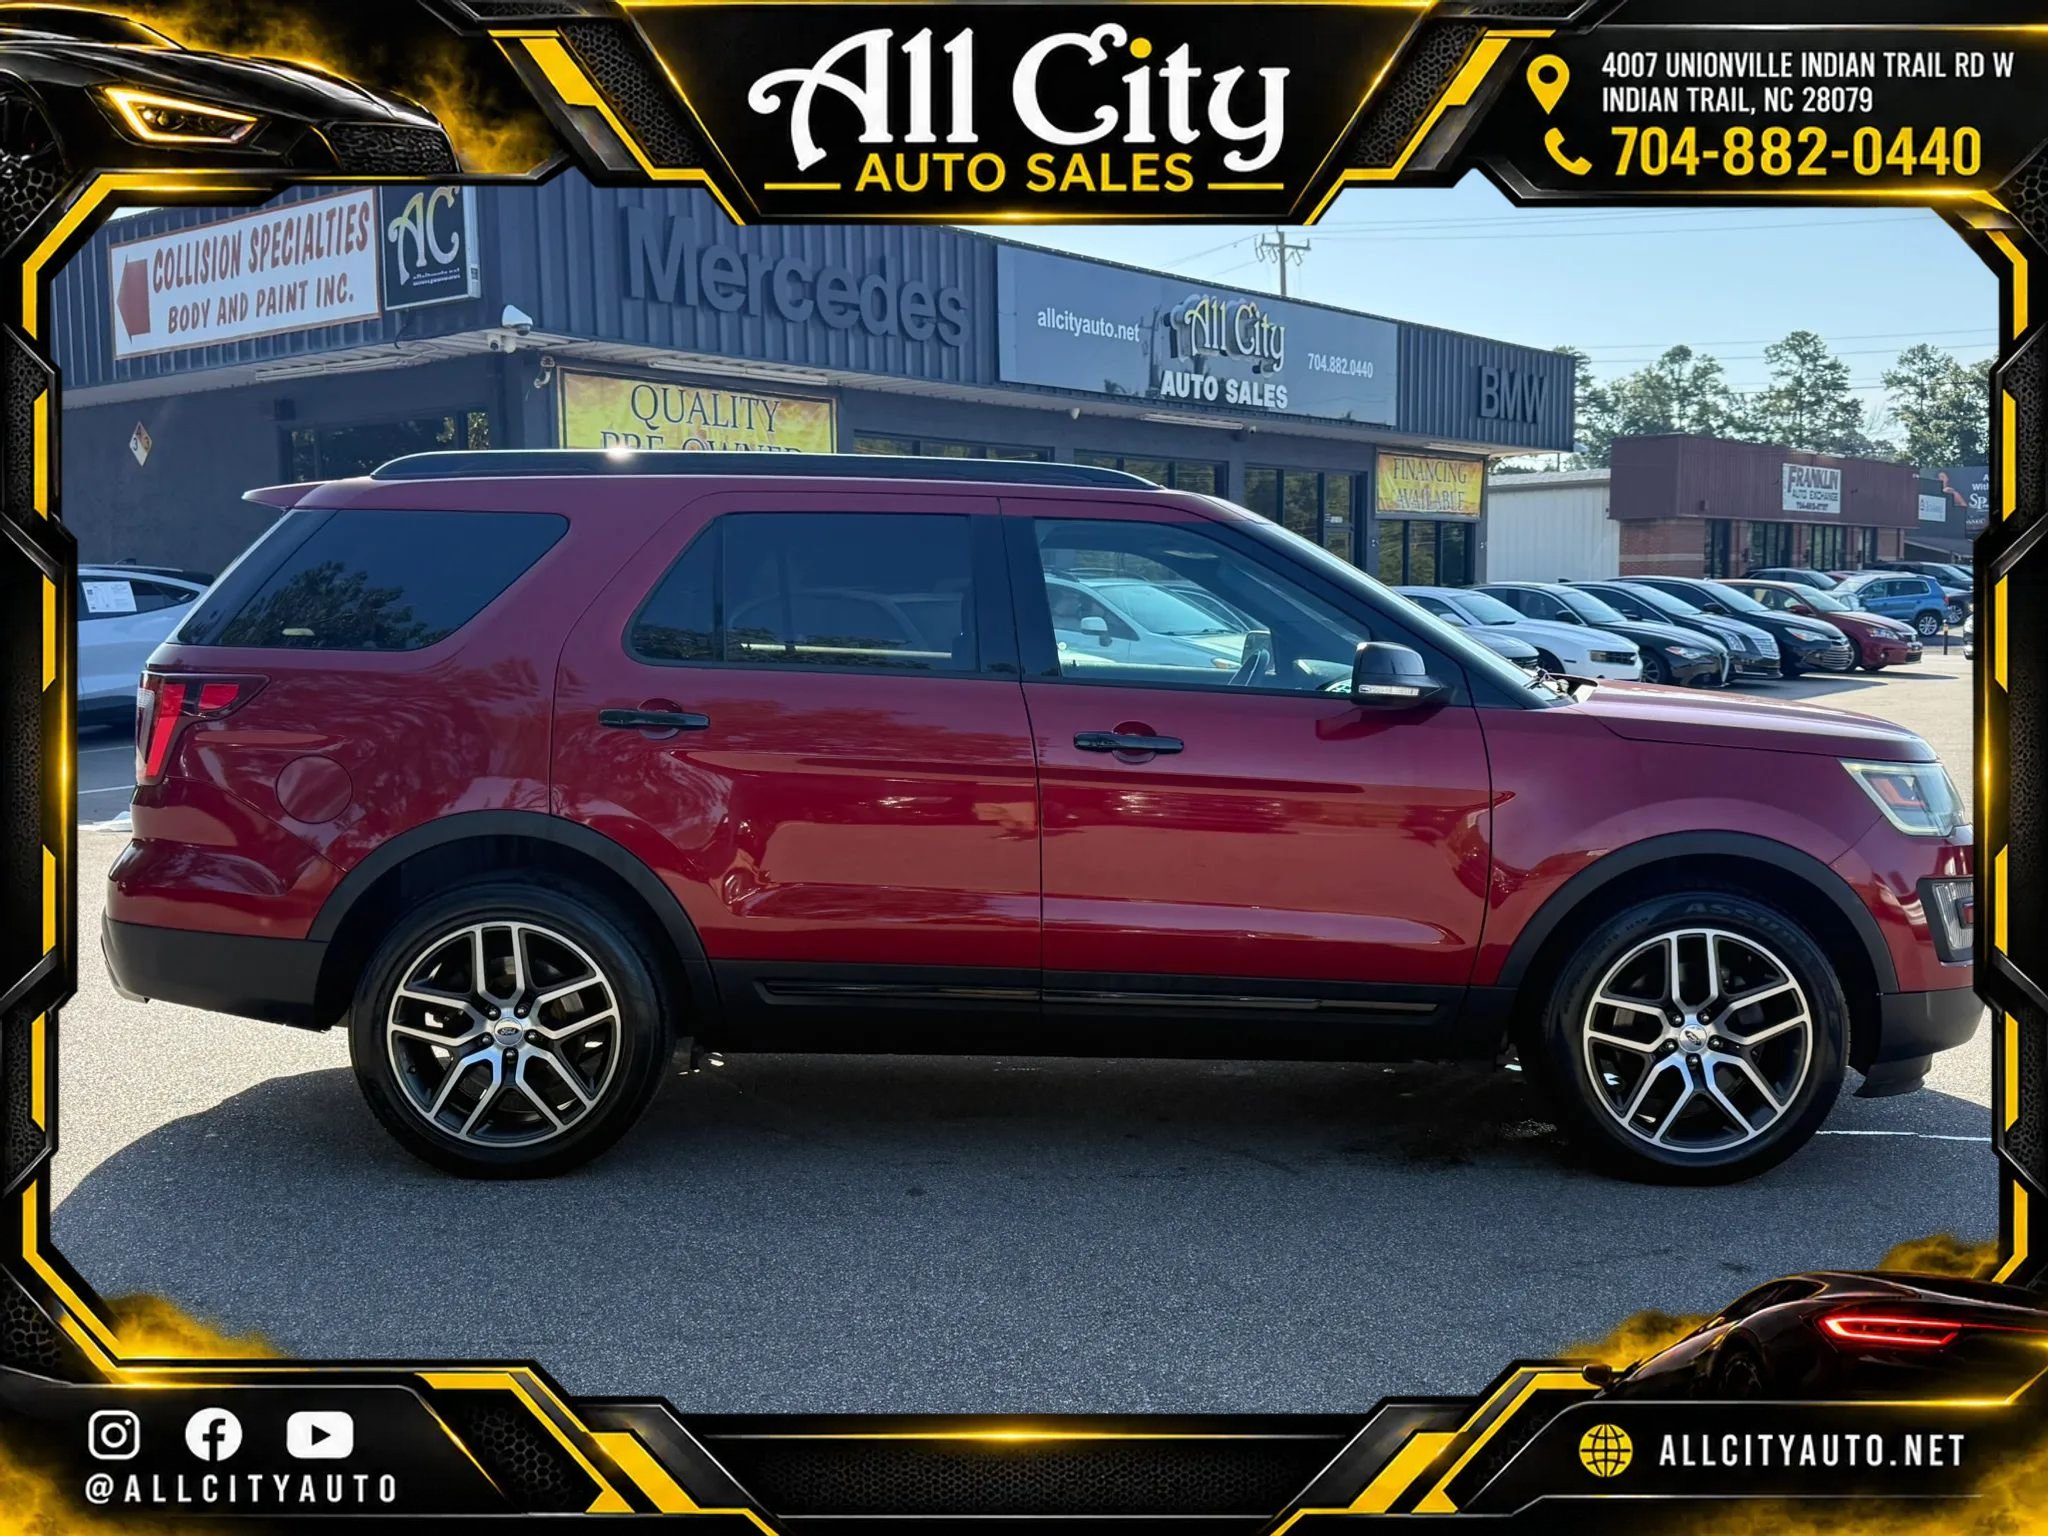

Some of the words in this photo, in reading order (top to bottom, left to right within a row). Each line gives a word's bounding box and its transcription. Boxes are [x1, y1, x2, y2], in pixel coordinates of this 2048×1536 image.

[152, 229, 242, 294] COLLISION
[248, 201, 370, 273] SPECIALTIES
[388, 186, 460, 285] AC
[622, 206, 969, 348] Mercedes
[168, 300, 209, 334] BODY
[217, 293, 248, 327] AND
[256, 280, 308, 322] PAINT
[316, 272, 354, 308] INC.
[1037, 308, 1140, 343] allcityauto.net
[1184, 298, 1227, 357] All
[1235, 301, 1285, 373] City
[1160, 369, 1219, 401] AUTO
[1225, 378, 1289, 409] SALES
[1307, 353, 1374, 379] 704.882.0440
[631, 384, 780, 433] QUALITY
[1478, 364, 1547, 424] BMW
[1393, 458, 1468, 484] FINANCING
[1787, 466, 1839, 492] FRANKLIN
[1396, 487, 1466, 512] AVAILABLE
